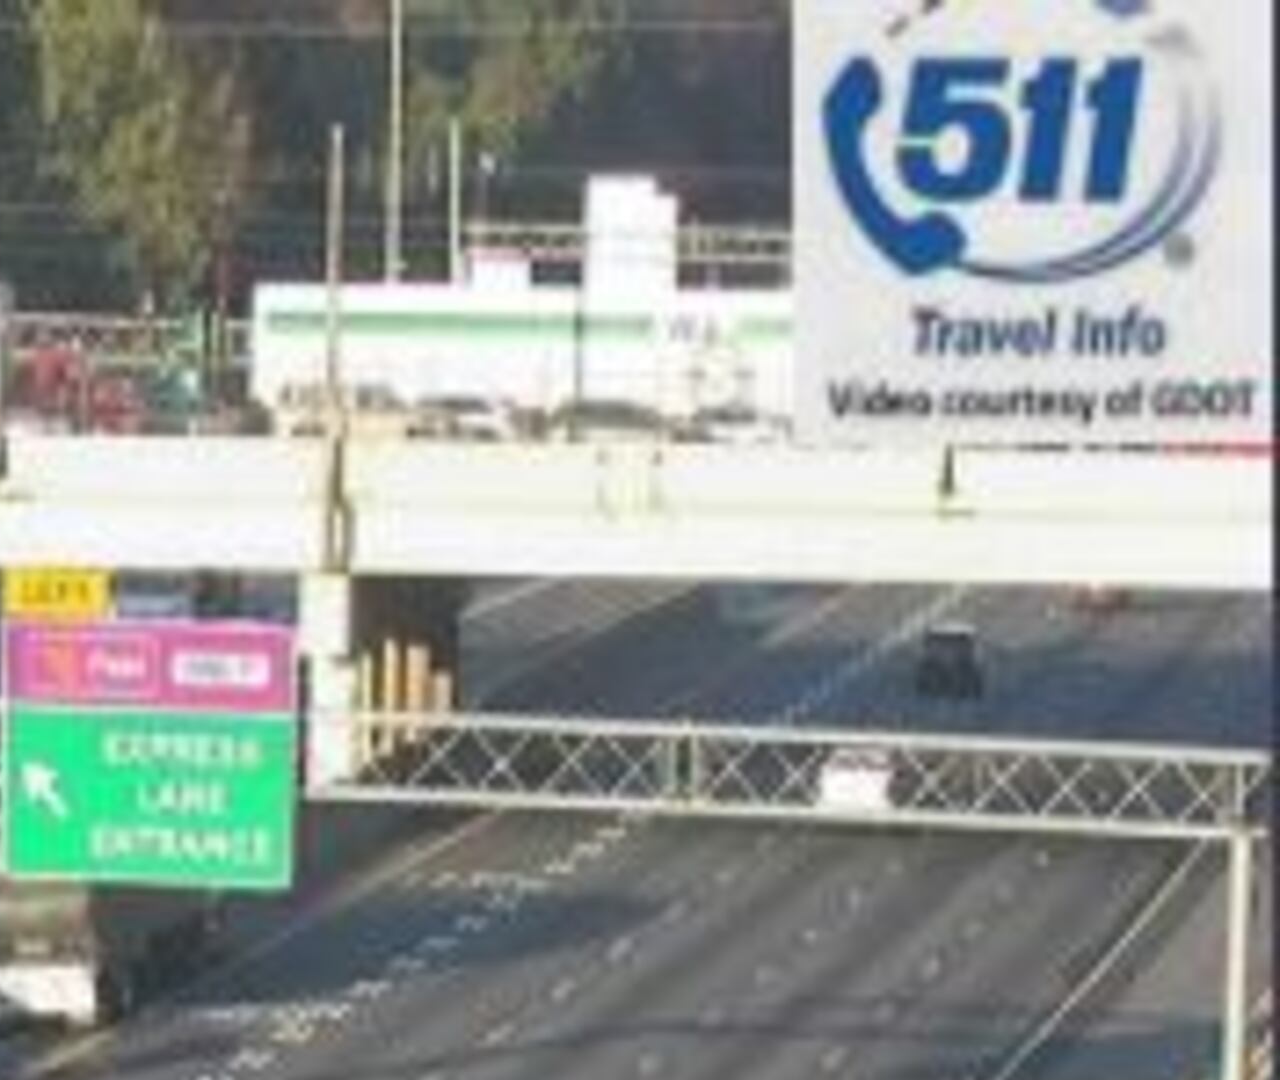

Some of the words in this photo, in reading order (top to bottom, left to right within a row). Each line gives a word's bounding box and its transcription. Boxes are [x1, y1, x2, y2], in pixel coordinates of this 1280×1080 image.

[102, 733, 264, 768] EXPRESS
[137, 783, 226, 815] LANE
[90, 827, 271, 866] ENTRANCE
